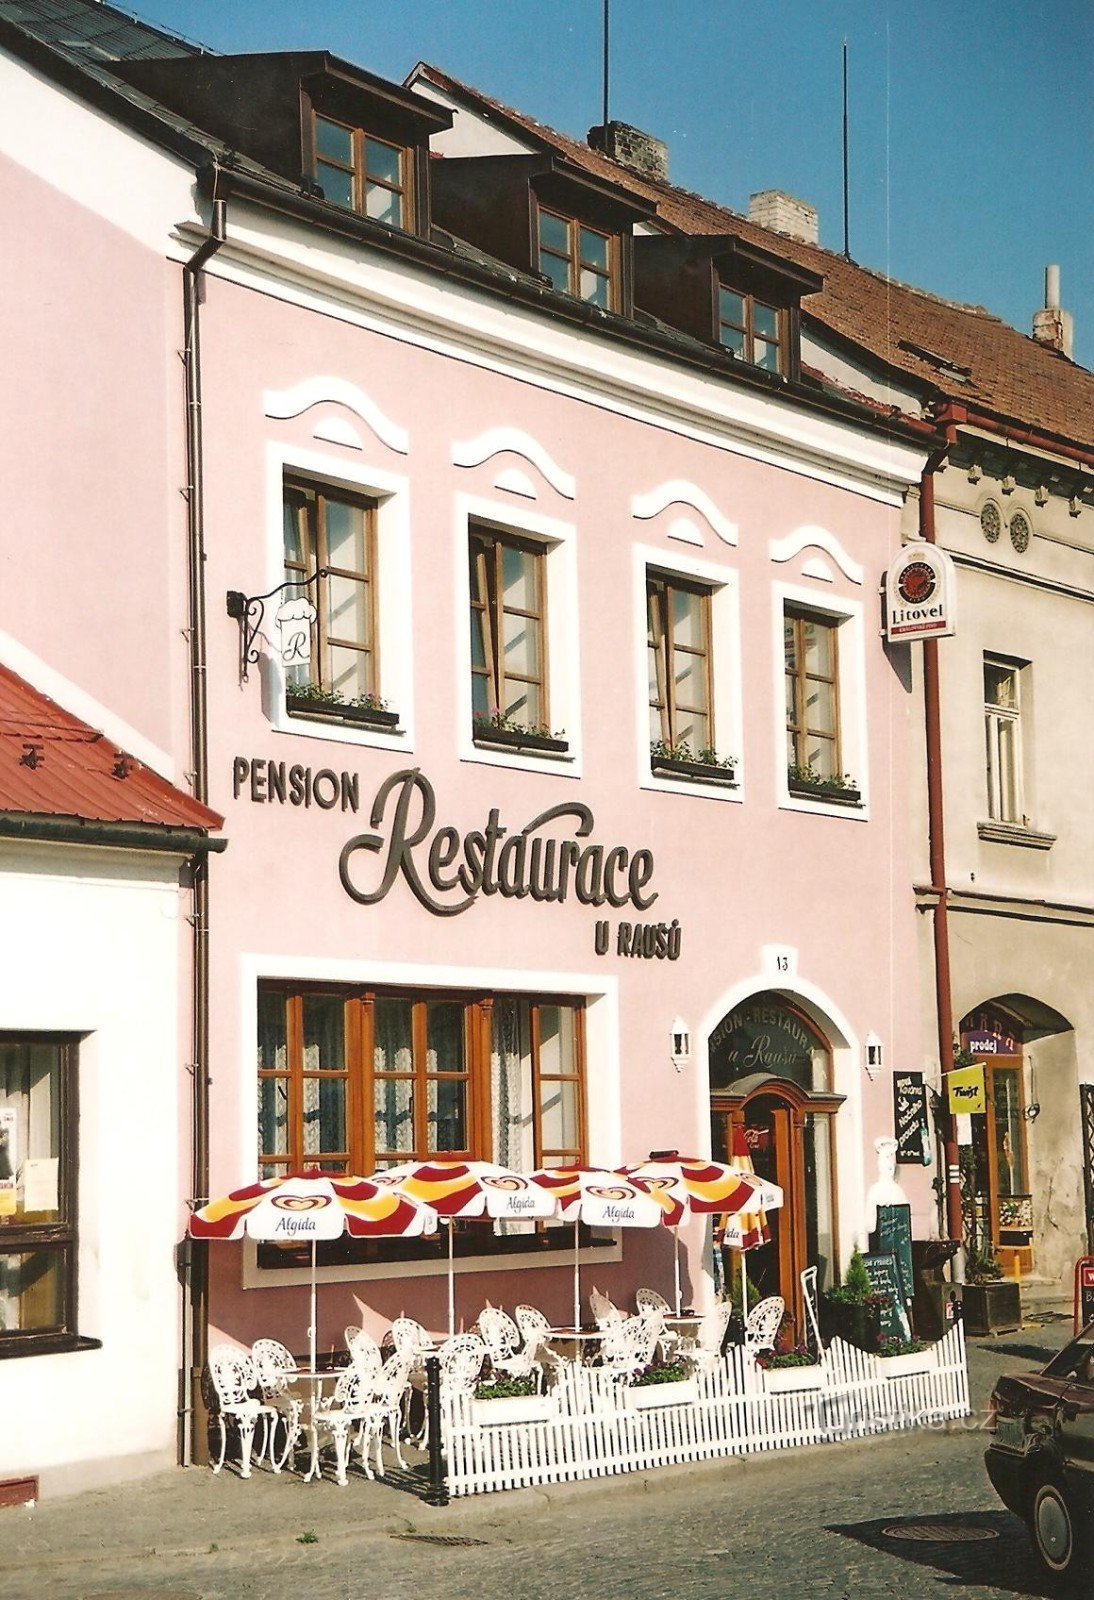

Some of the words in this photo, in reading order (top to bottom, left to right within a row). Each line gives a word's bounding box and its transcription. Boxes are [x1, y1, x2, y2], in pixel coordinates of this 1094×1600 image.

[892, 604, 943, 625] Litovel
[282, 631, 310, 662] R
[232, 756, 360, 813] PENSION
[338, 766, 659, 917] Restaurace
[595, 920, 610, 956] U
[776, 956, 789, 971] 13
[970, 1039, 997, 1054] prodej
[952, 1086, 979, 1099] Twist
[507, 1196, 536, 1213] Algida
[602, 1205, 635, 1223] Algida
[275, 1216, 316, 1237] Algida
